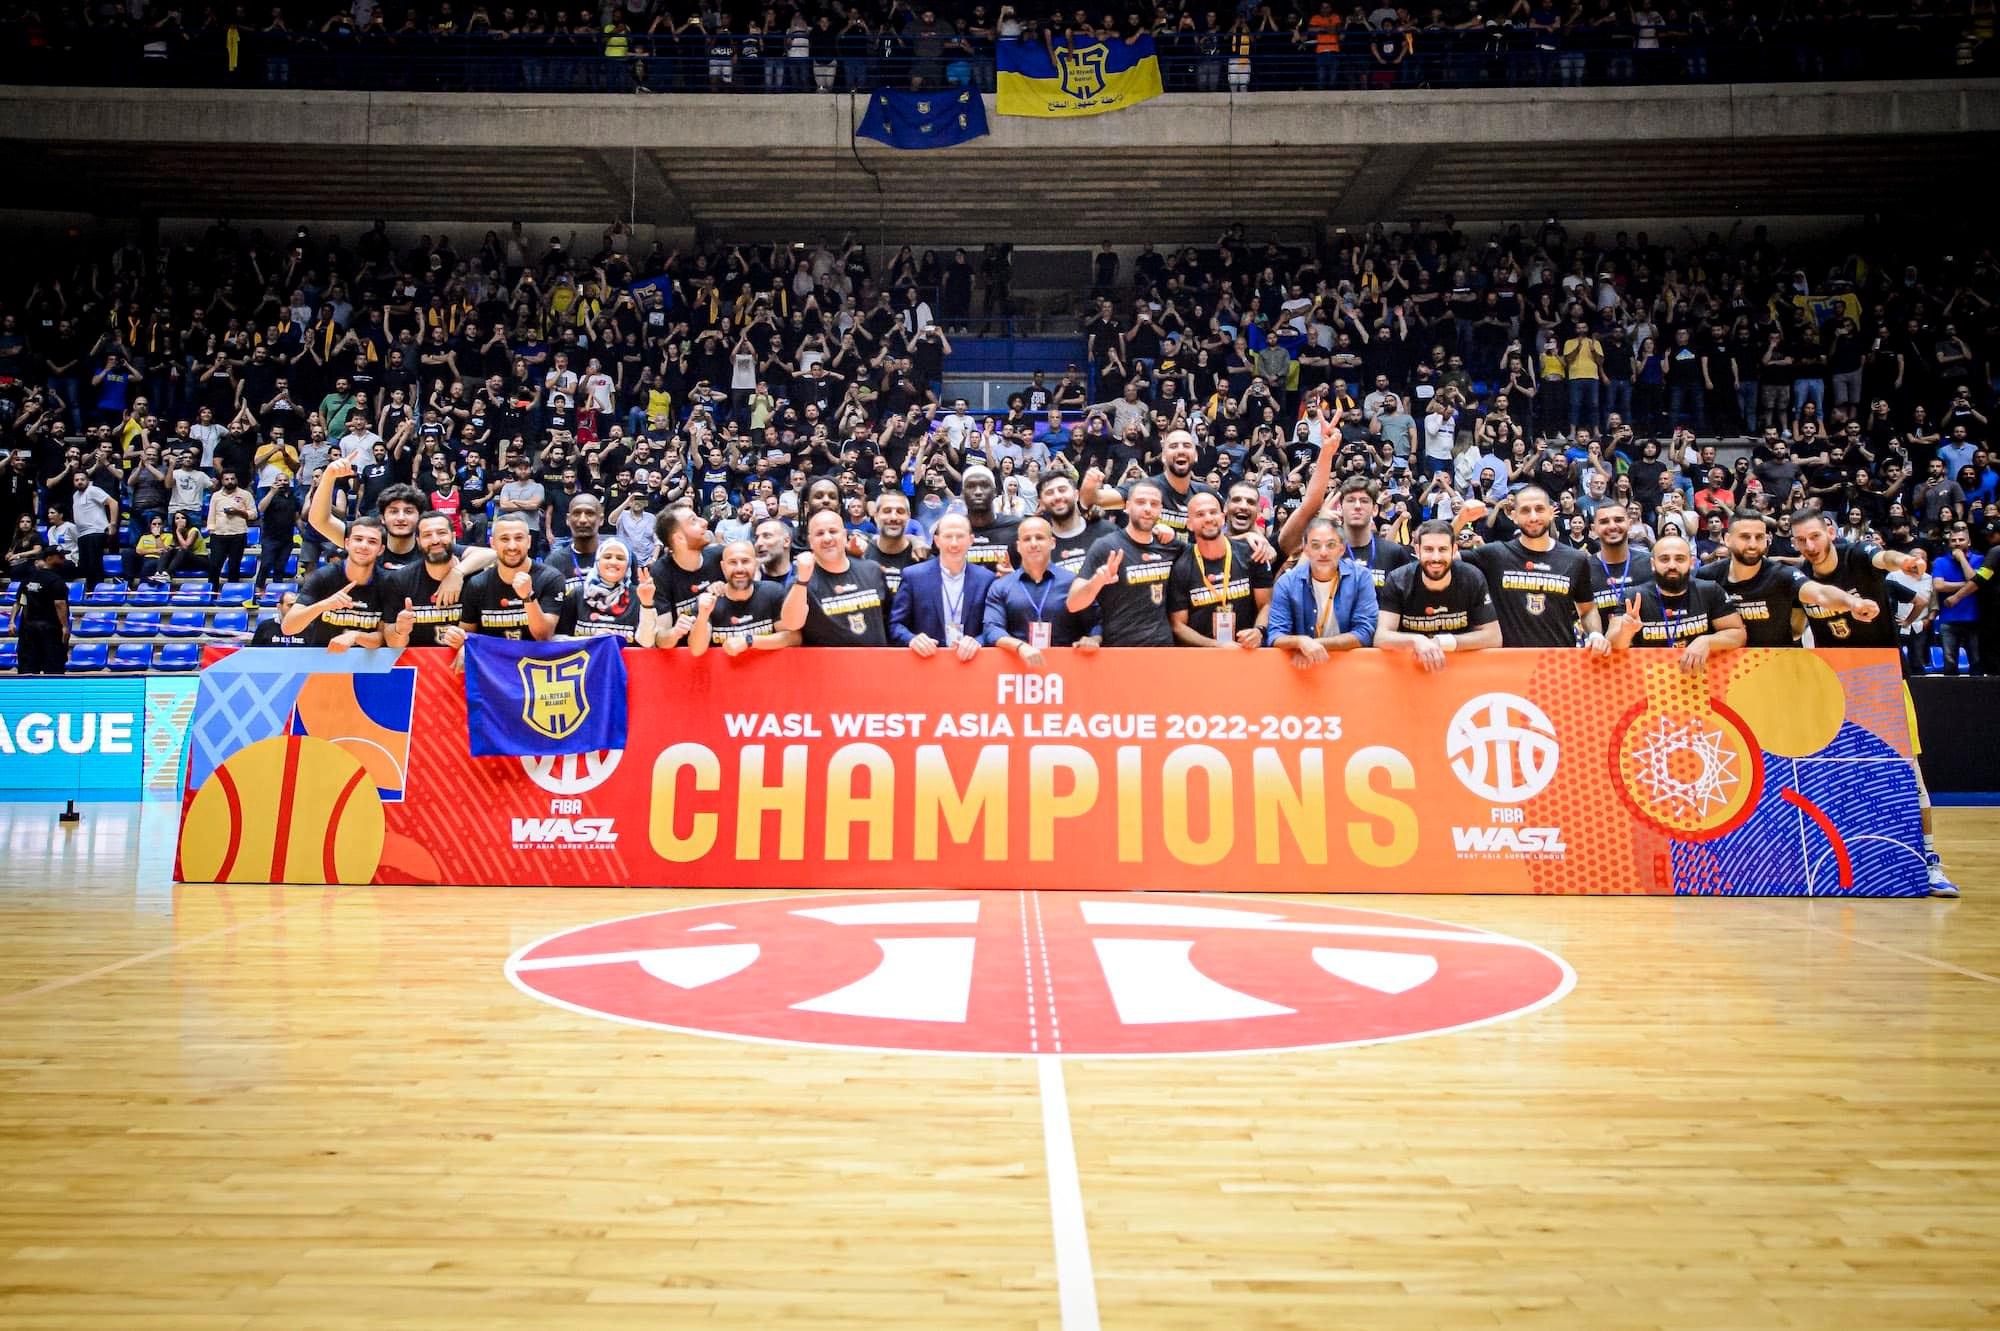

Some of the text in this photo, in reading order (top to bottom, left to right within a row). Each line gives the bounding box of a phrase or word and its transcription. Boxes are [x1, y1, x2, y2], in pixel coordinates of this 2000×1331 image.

[1190, 582, 1251, 607] CHAIONS
[1502, 575, 1570, 595] CHAMPIONS
[1402, 615, 1468, 632] CHAMPIONS
[997, 673, 1064, 705] FIBA
[724, 713, 1343, 741] WASL WEST ASIA LEAGUE 2022-2023
[550, 798, 582, 815] FIBA
[649, 742, 1419, 868] CHAMPIONS
[1491, 807, 1524, 823] FIBA
[1533, 853, 1566, 861] LEAGUE
